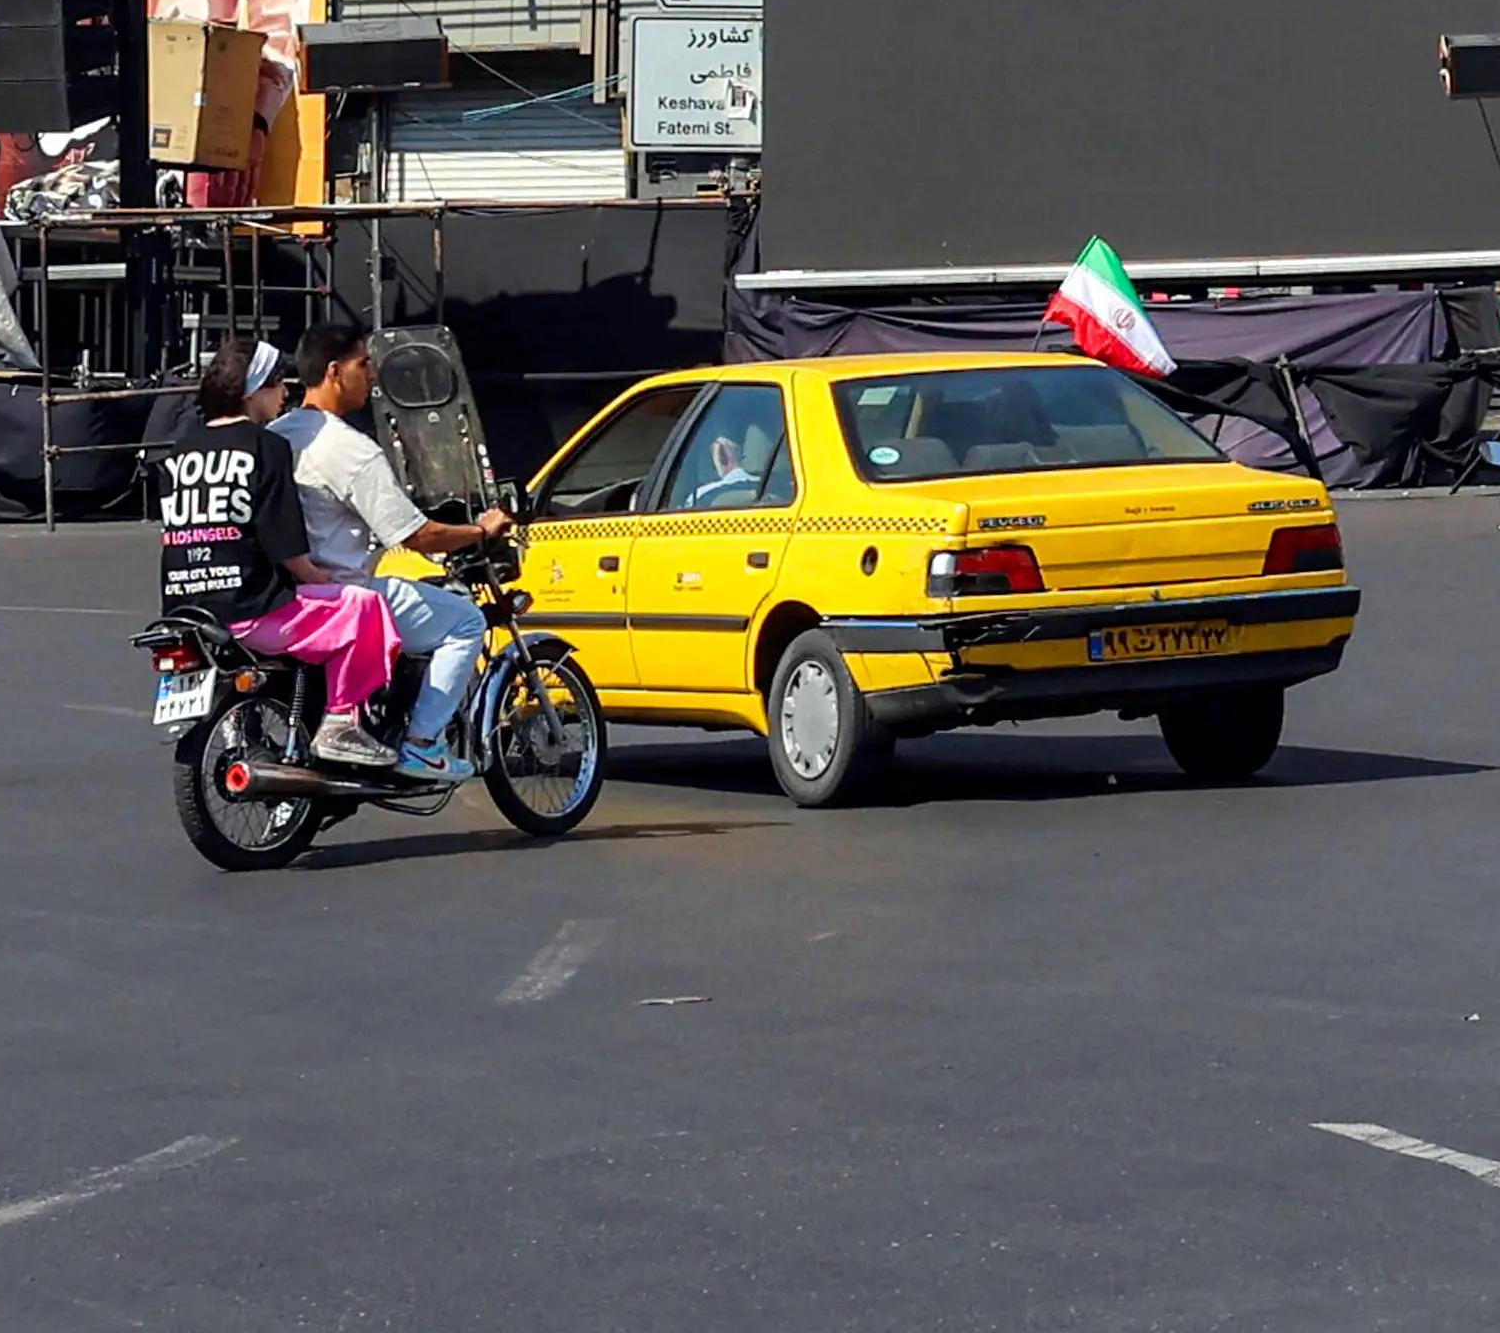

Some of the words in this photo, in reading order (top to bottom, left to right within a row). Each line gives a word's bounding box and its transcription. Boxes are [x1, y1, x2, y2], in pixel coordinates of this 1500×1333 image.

[688, 26, 753, 48] کشاورز
[690, 63, 752, 84] فاطمی
[658, 96, 726, 111] Keshava
[657, 121, 710, 135] Fatemi
[714, 121, 734, 135] St.
[165, 450, 254, 489] YOUR
[187, 547, 211, 563] 192
[209, 565, 240, 578] YOUR
